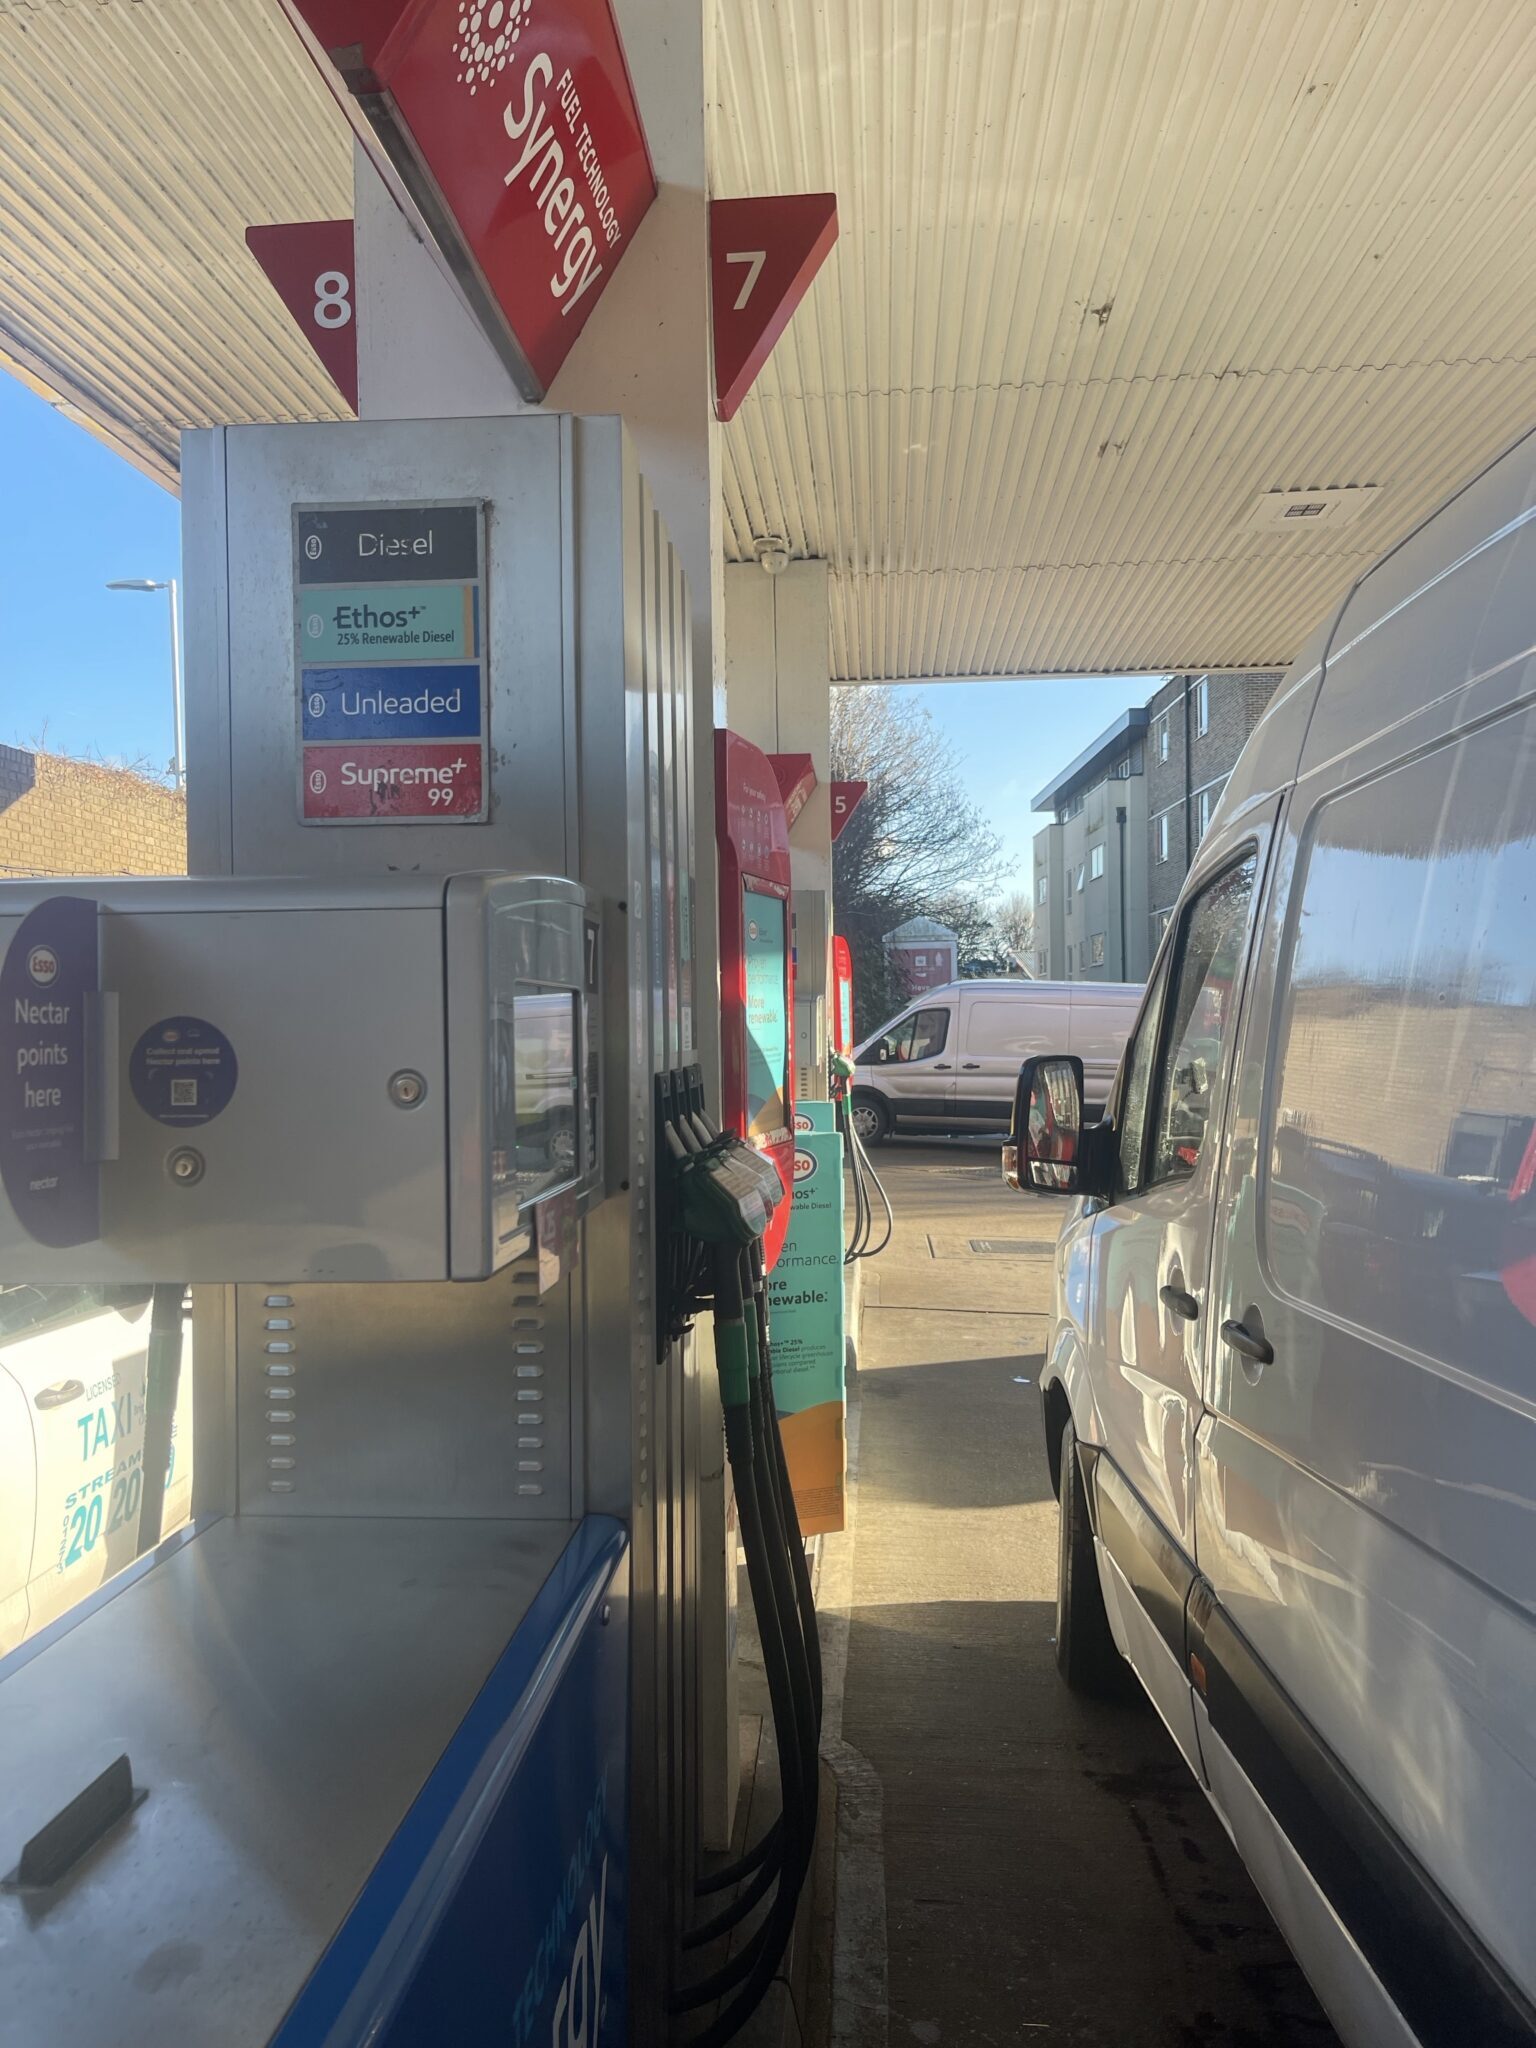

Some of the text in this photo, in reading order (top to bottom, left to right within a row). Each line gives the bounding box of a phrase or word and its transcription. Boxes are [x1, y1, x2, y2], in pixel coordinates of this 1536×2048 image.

[556, 68, 622, 248] FUEL TECHNOLOGY
[503, 52, 603, 316] Synergy
[726, 251, 767, 310] 7
[314, 271, 351, 329] 8
[358, 530, 433, 556] Diesel
[337, 629, 455, 646] 25% Renewable Diesel
[341, 688, 461, 715] Unleaded
[427, 788, 453, 806] 99
[834, 796, 847, 814] 5
[32, 956, 55, 973] Esso
[15, 998, 70, 1024] Nectar
[17, 1040, 68, 1074] points
[25, 1081, 61, 1108] here
[811, 1201, 832, 1210] Diesel
[776, 1254, 839, 1268] ormance.
[86, 1373, 121, 1402] LICENSED
[78, 1392, 132, 1462] TAXI
[65, 1450, 141, 1510] STREAM
[64, 1467, 142, 1568] 20 20
